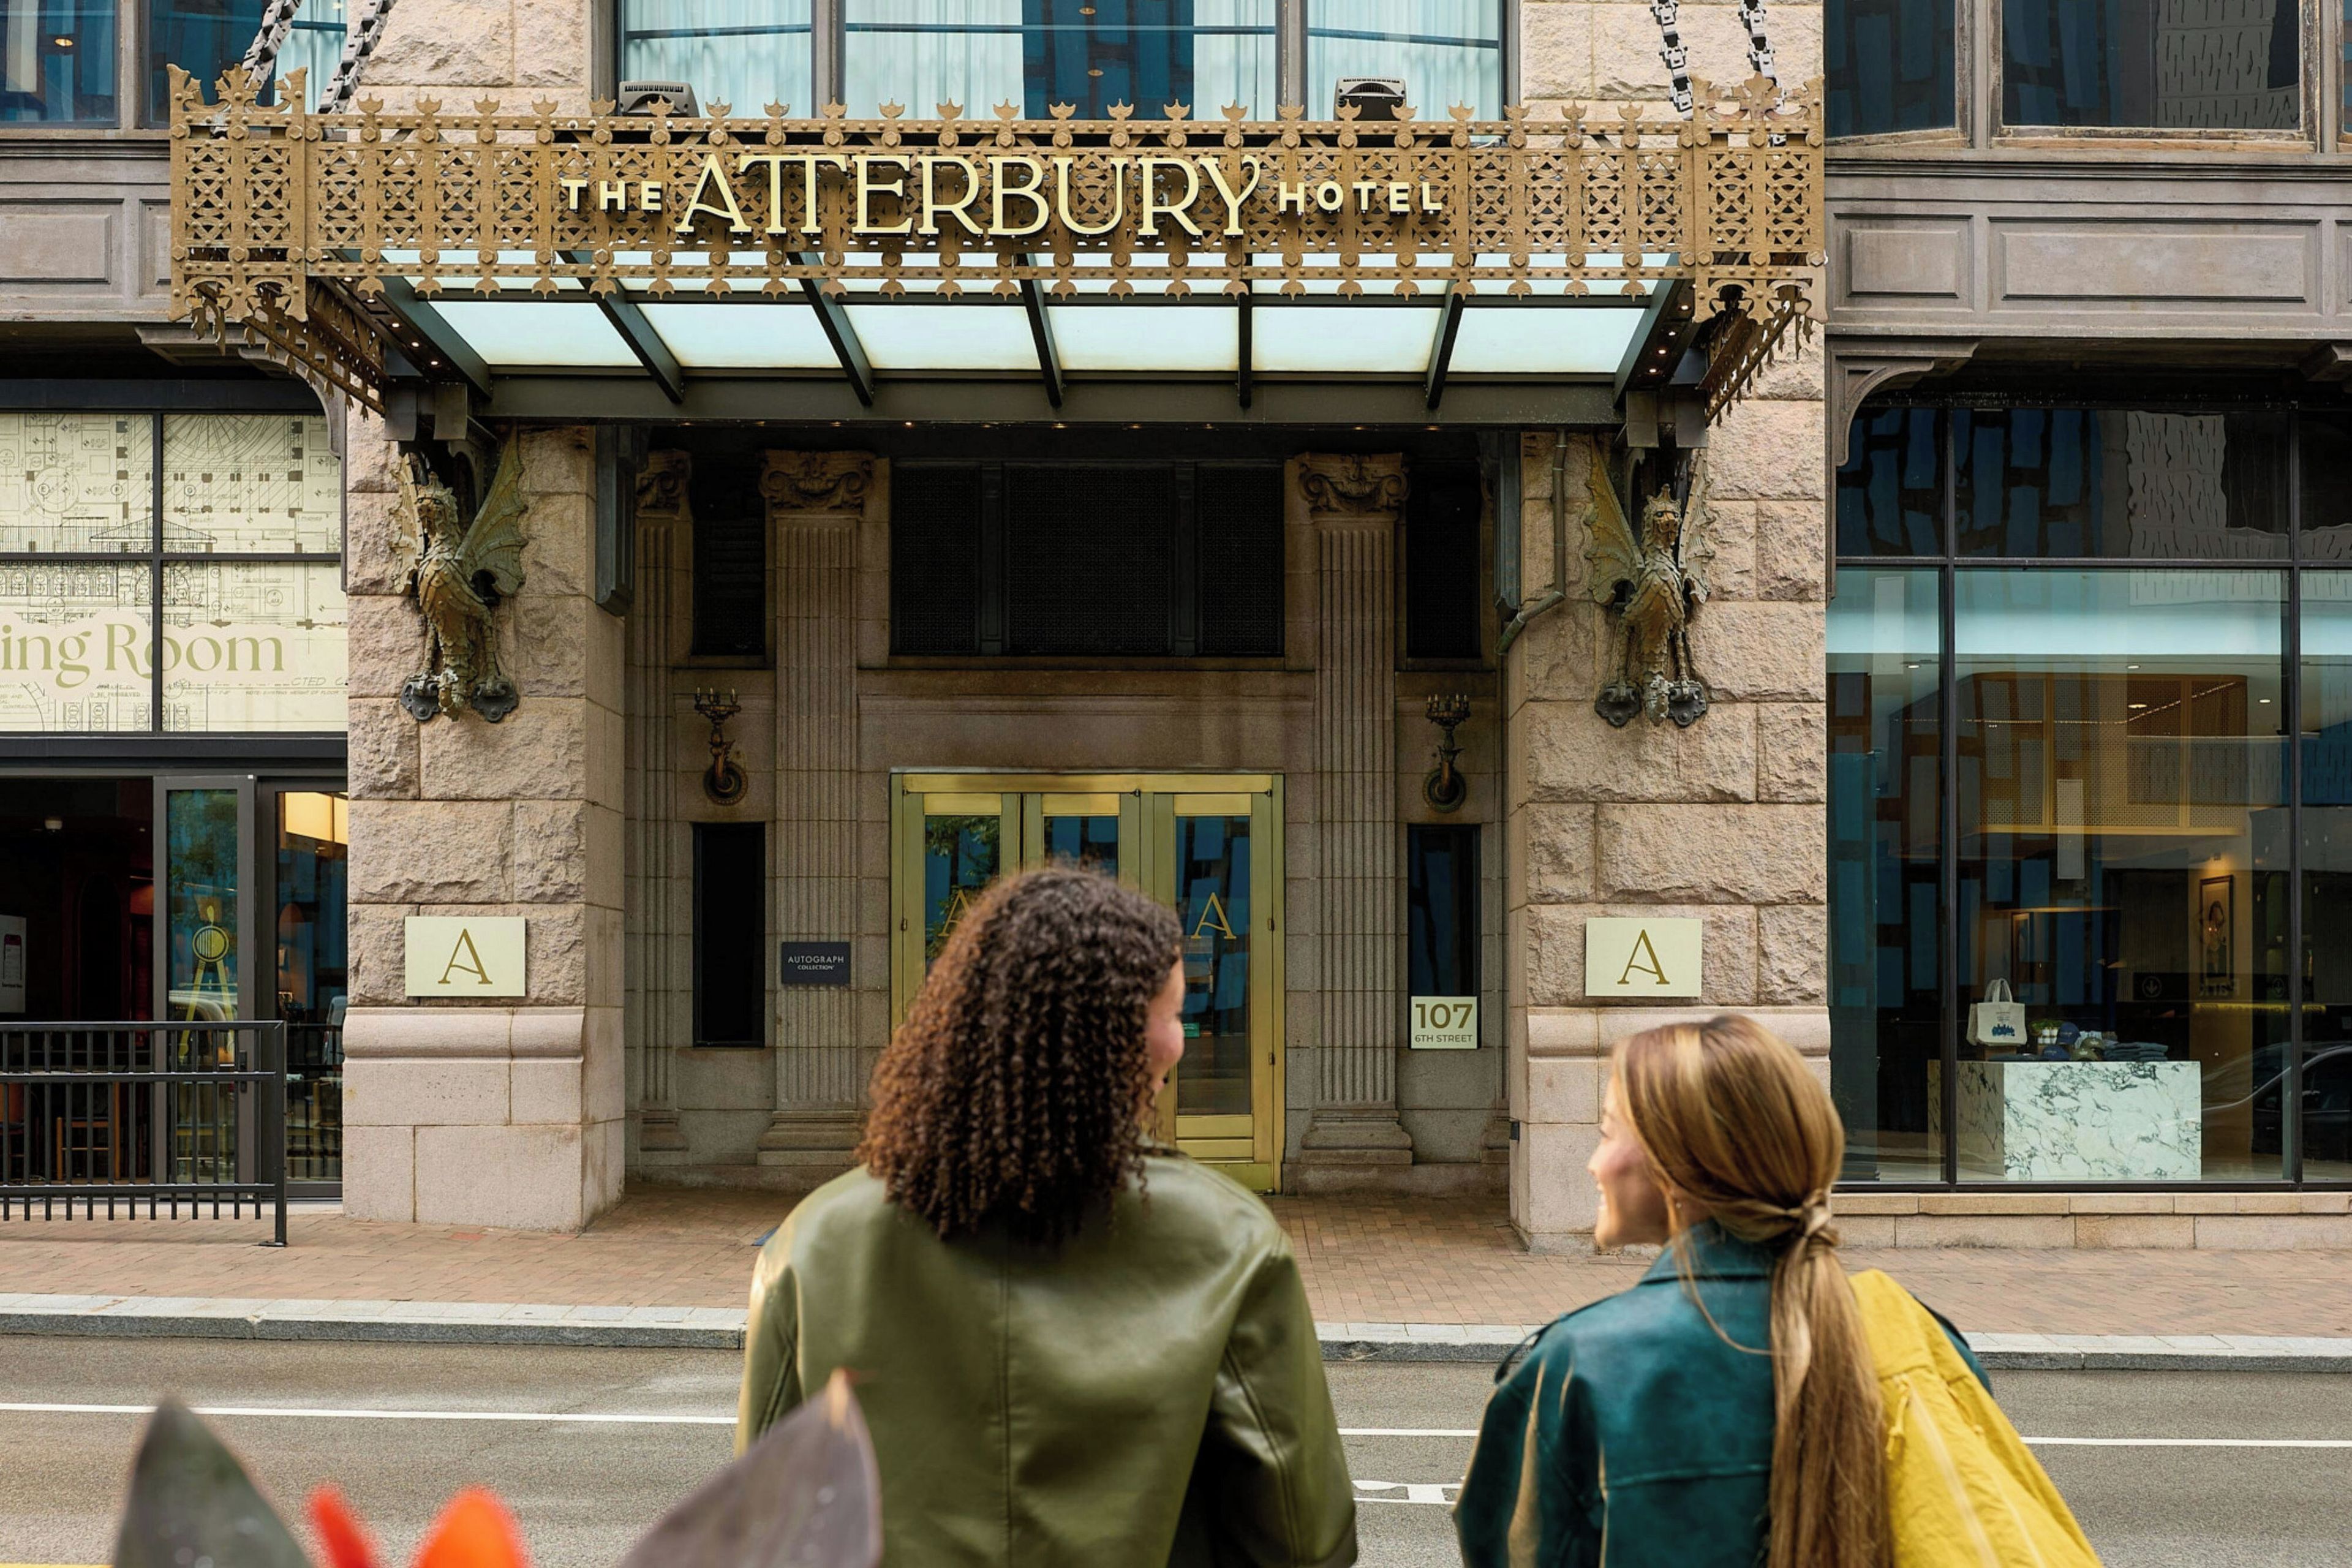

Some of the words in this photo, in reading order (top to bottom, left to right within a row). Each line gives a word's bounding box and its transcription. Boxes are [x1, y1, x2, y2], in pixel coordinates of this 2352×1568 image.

[560, 179, 663, 211] THE
[674, 154, 1261, 236] ATTERBURY
[1279, 181, 1442, 212] HOTEL
[1, 624, 92, 688] ing
[104, 624, 285, 679] Room
[1191, 892, 1237, 939] A
[437, 928, 493, 985] A
[787, 955, 845, 963] AUTOGRAPH
[1616, 929, 1671, 985] A
[1415, 1003, 1473, 1029] 107
